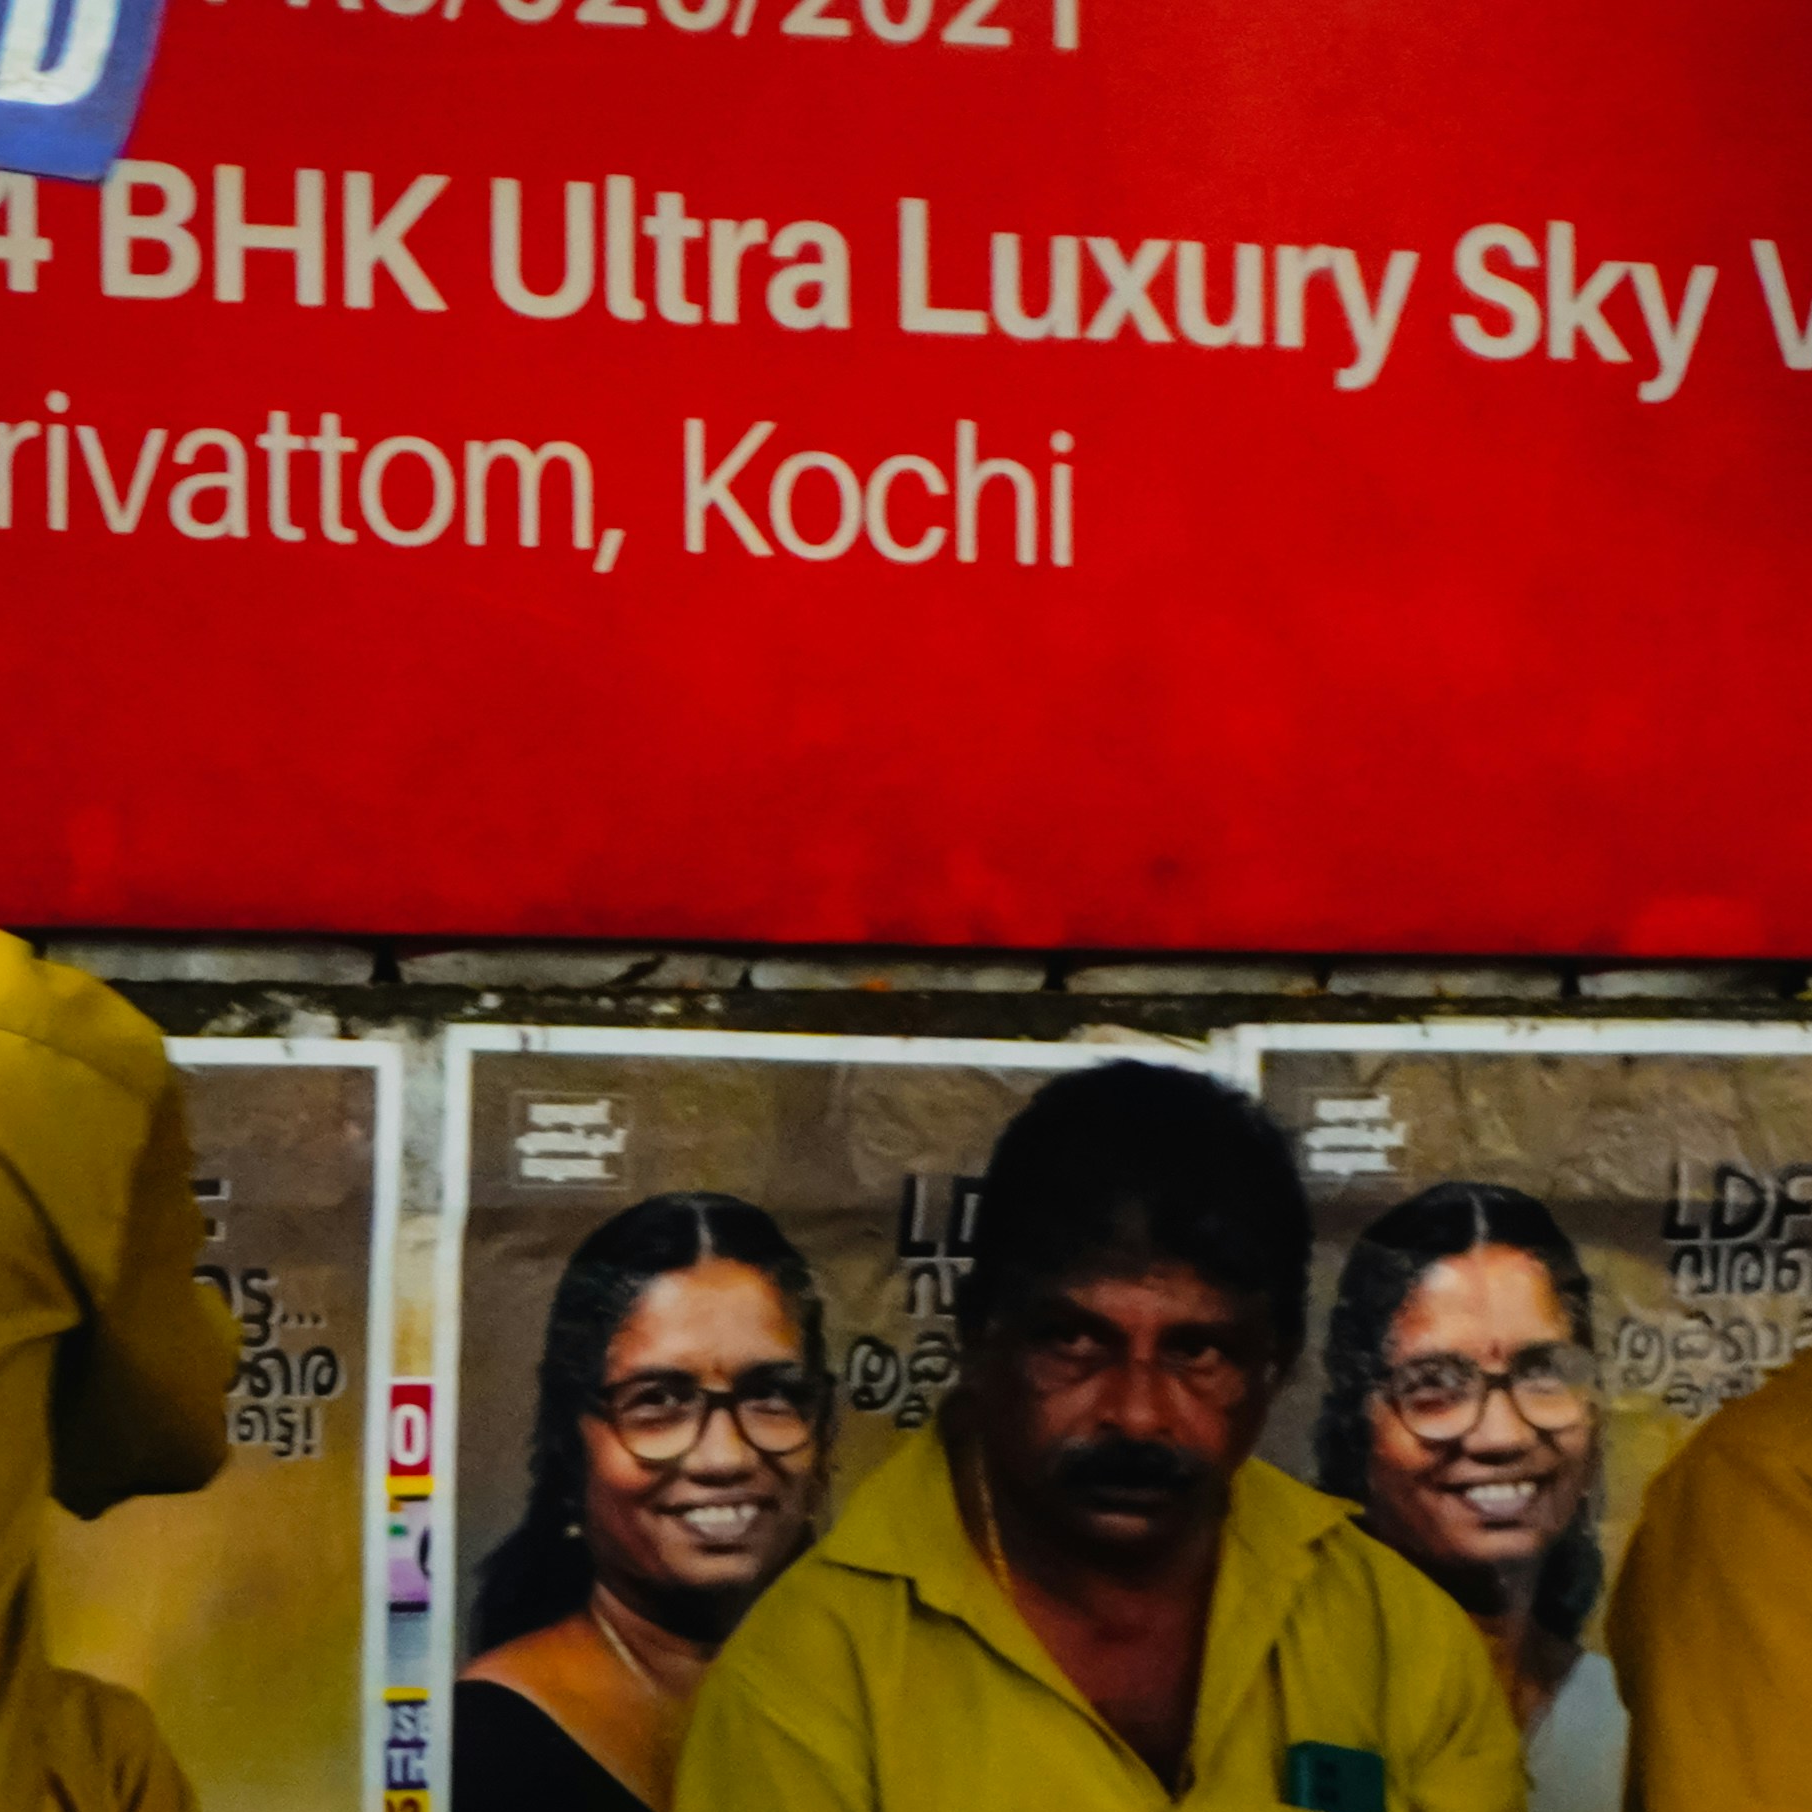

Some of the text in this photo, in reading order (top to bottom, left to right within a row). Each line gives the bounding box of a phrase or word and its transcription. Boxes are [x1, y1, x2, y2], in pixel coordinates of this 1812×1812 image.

[101, 160, 450, 311] BHK
[490, 174, 851, 330] Ultra
[898, 198, 1419, 389] Luxury
[1451, 219, 1719, 402] Sky
[683, 416, 1076, 568] Kochi
